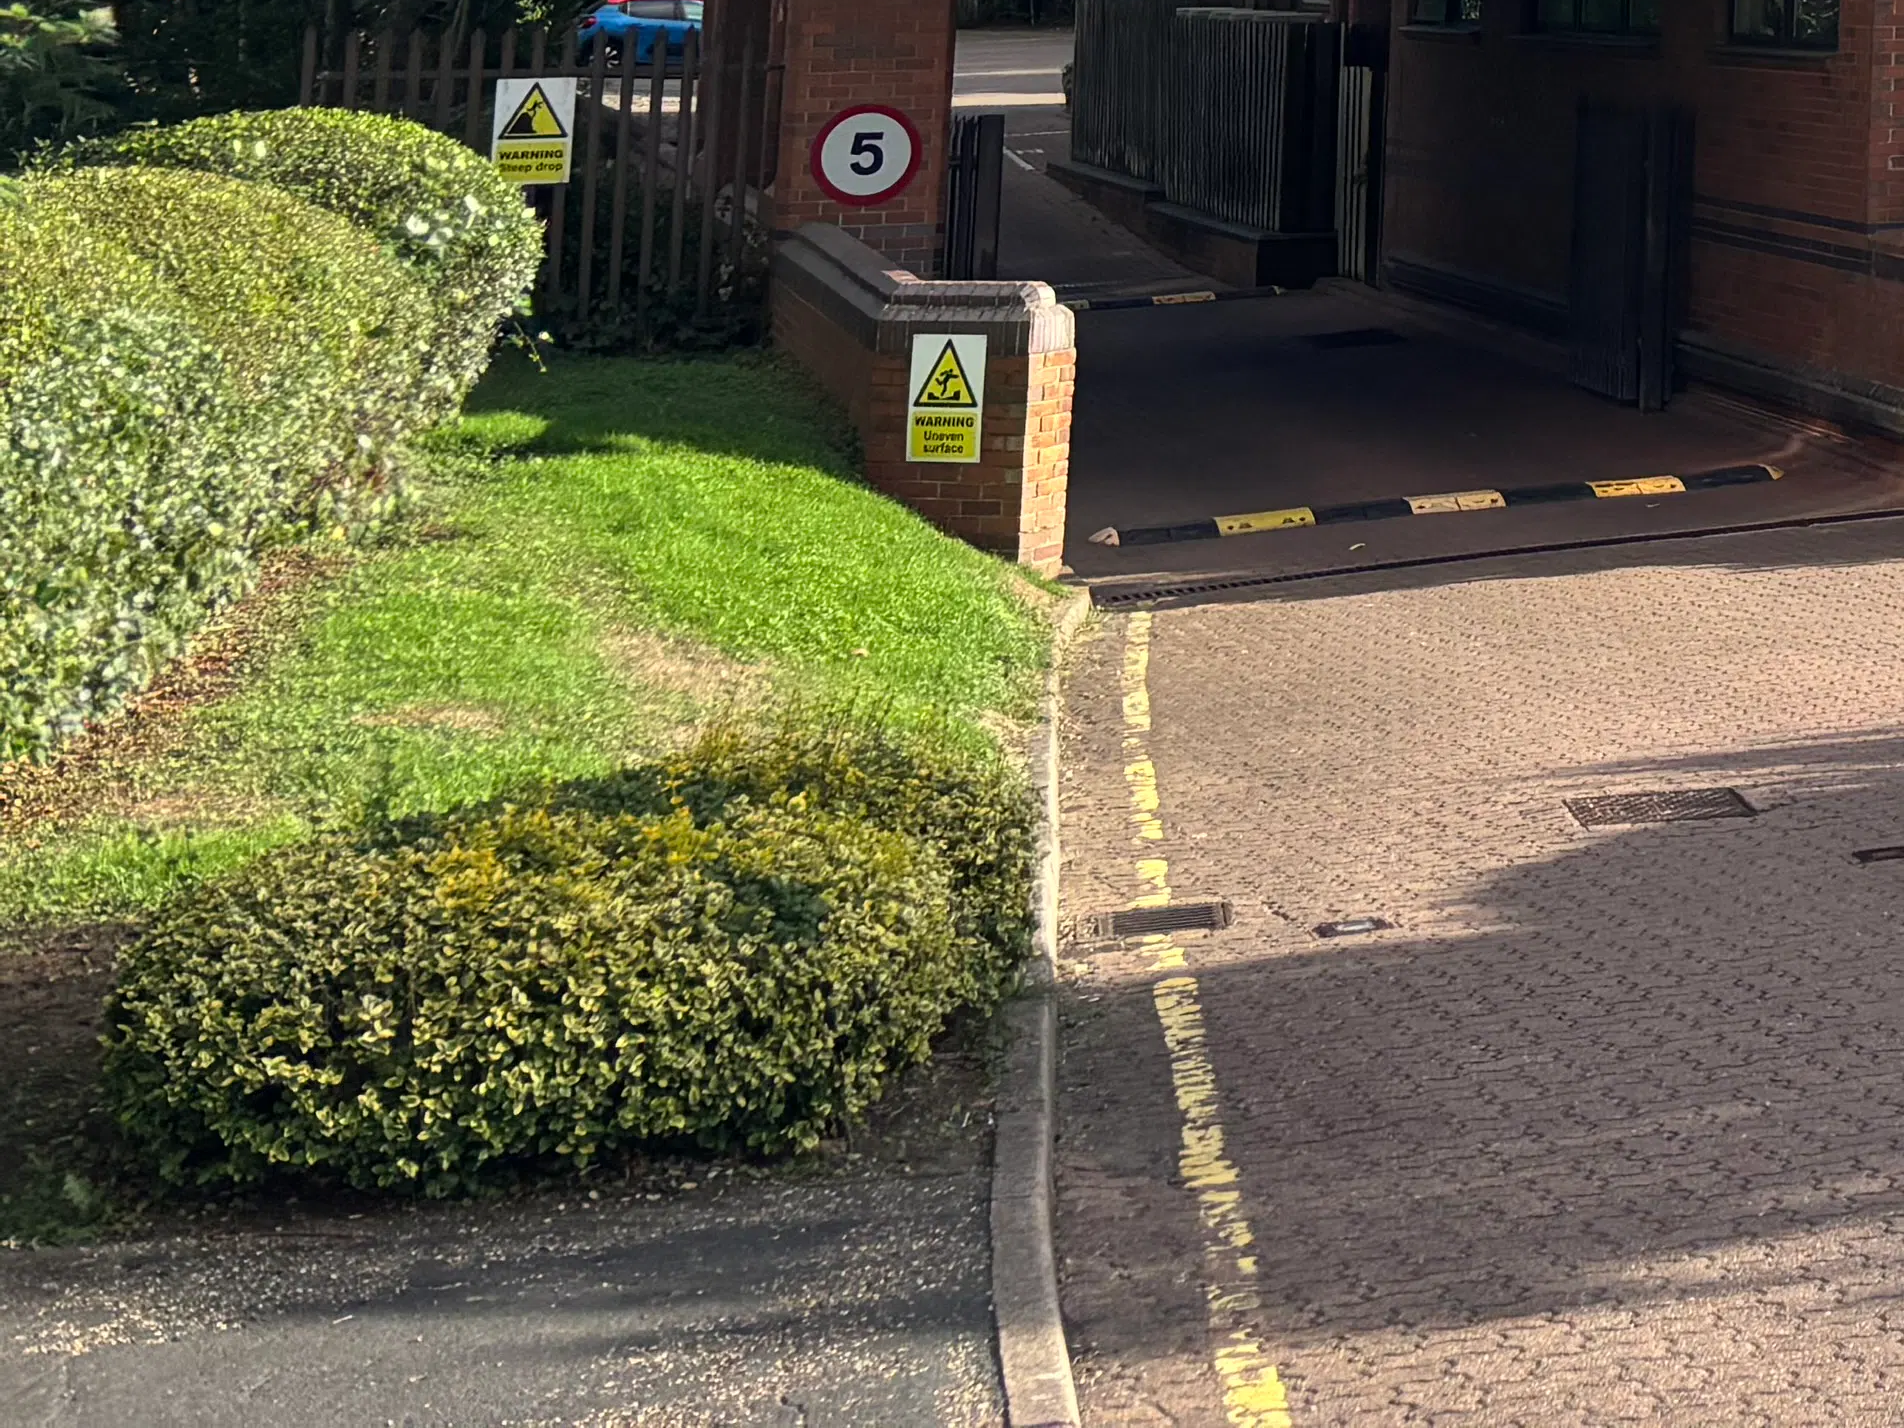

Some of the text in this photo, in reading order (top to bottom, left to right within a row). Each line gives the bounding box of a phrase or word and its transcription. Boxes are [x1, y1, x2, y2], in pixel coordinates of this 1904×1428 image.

[499, 150, 563, 160] WARNING
[849, 132, 885, 176] 5
[499, 162, 563, 173] Steep drop
[915, 416, 974, 427] WARNING
[924, 430, 964, 441] Uneven
[923, 442, 964, 454] surface
